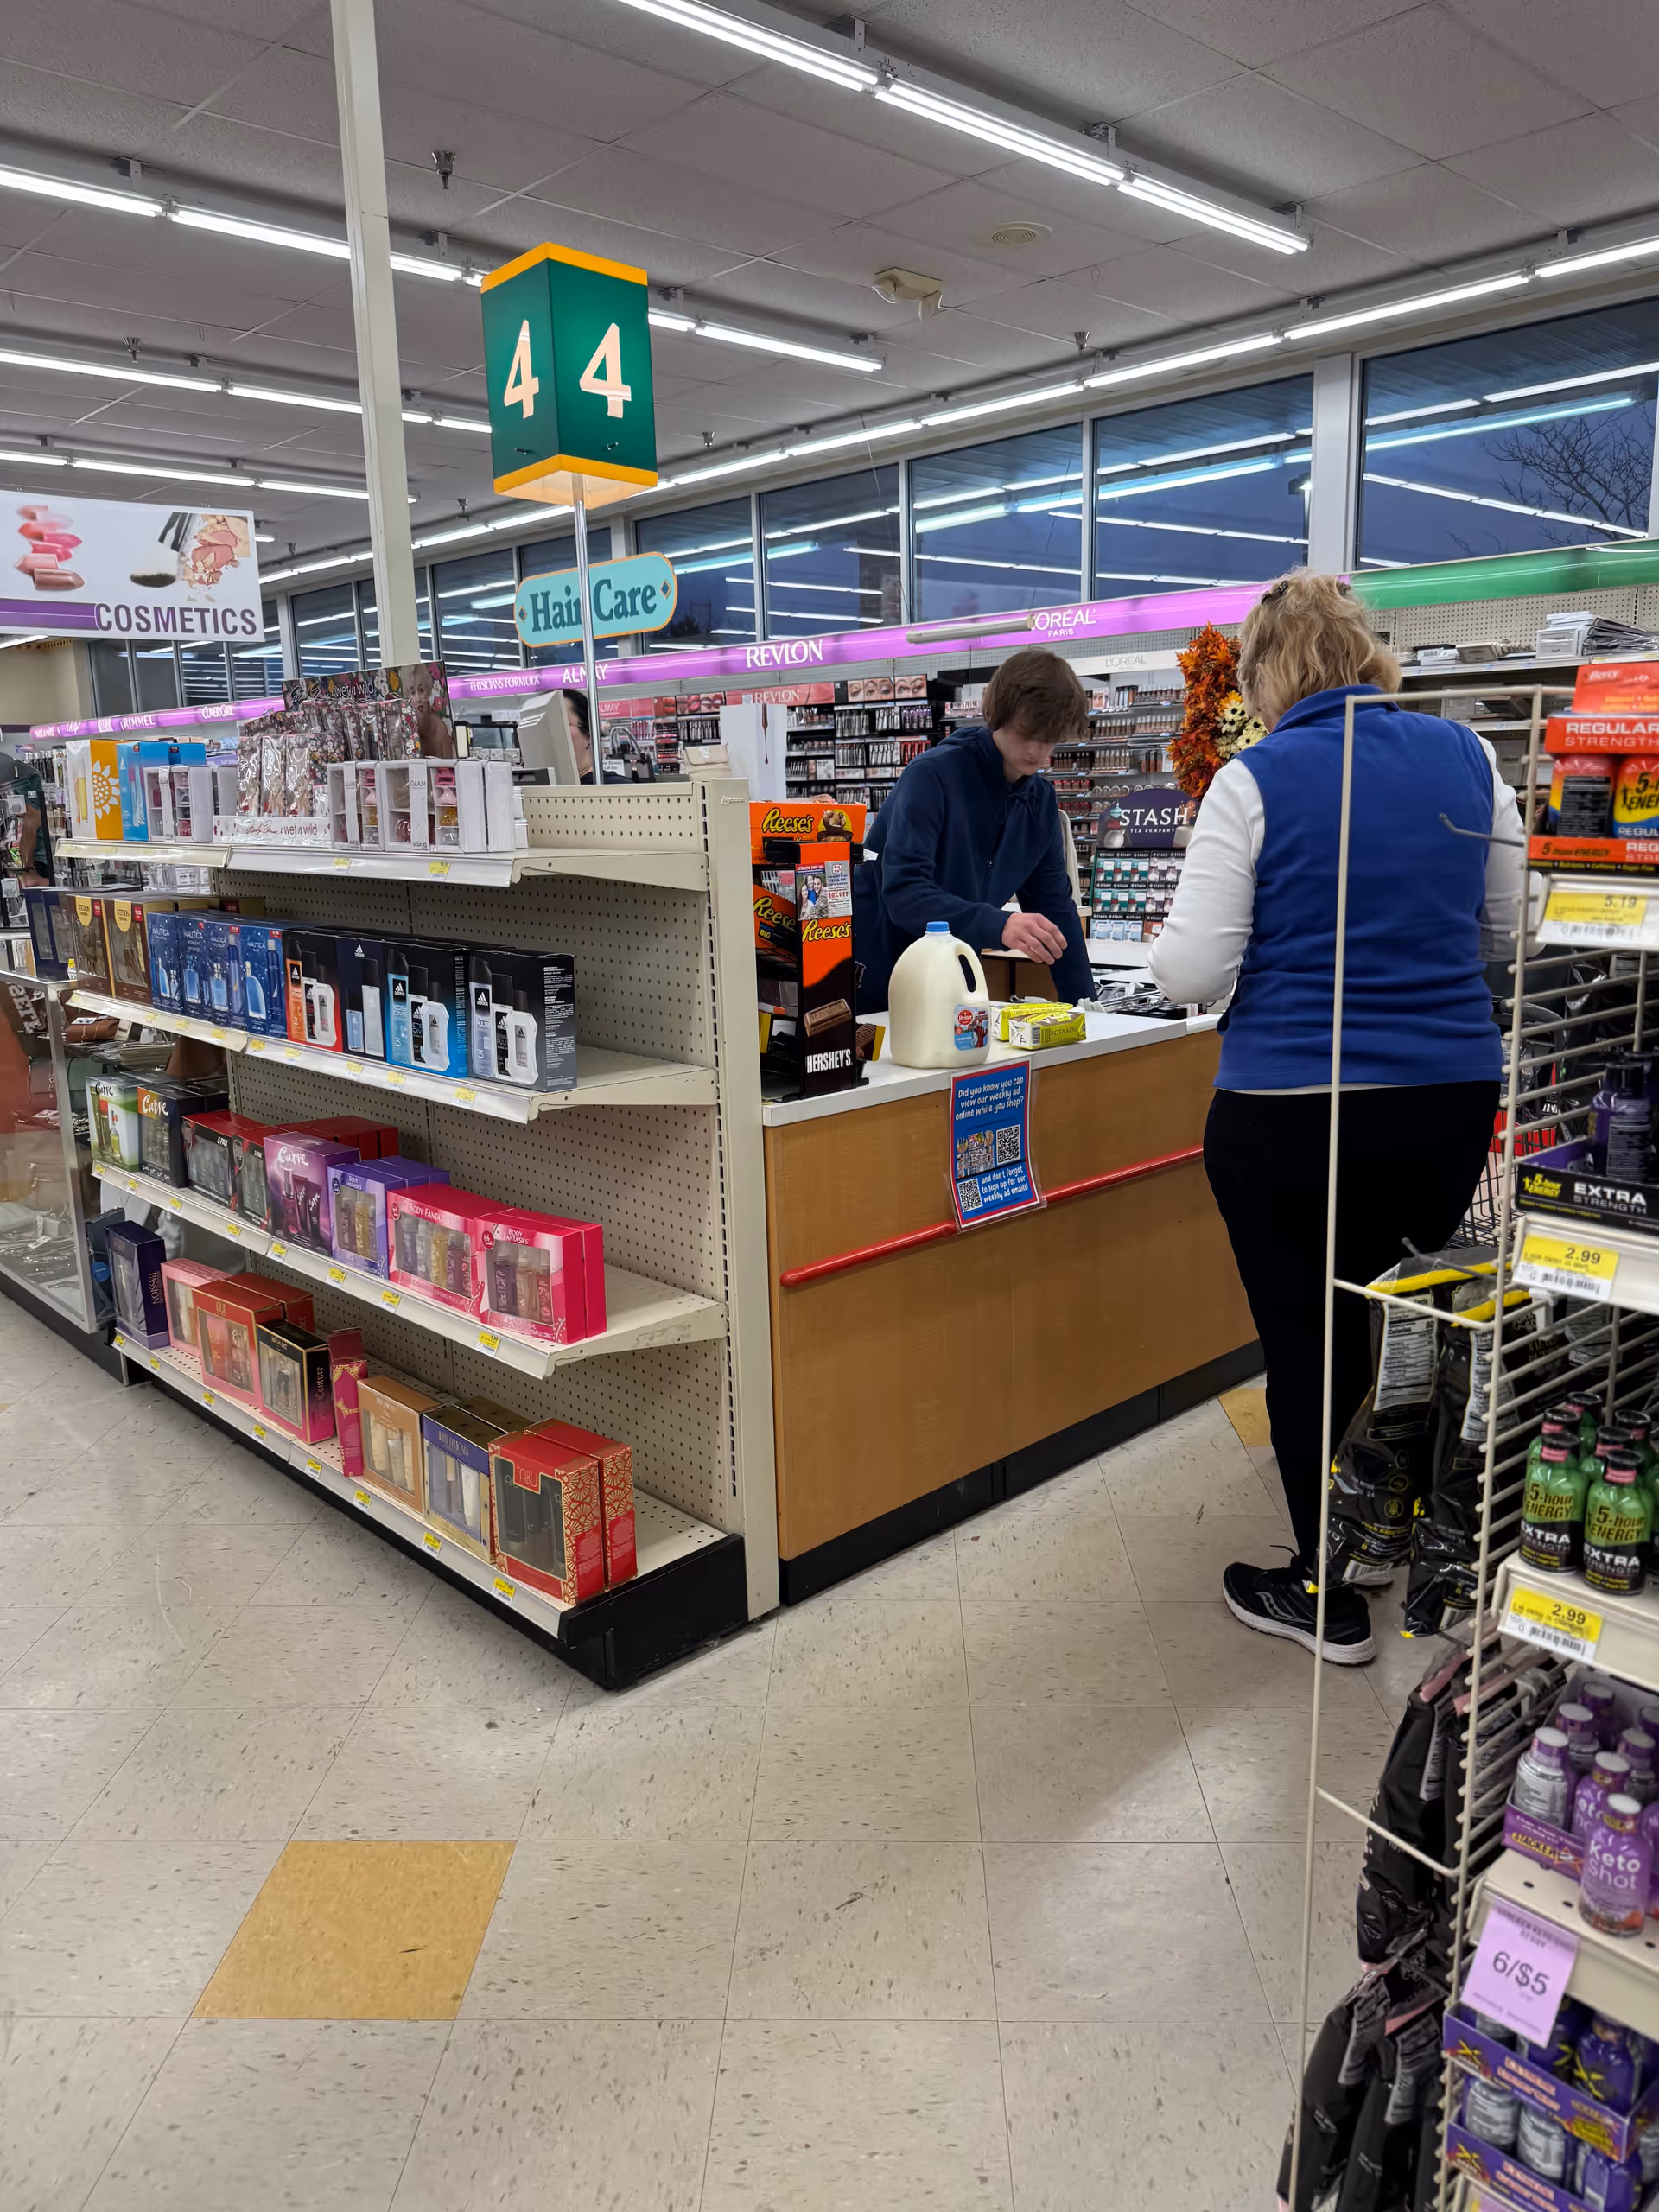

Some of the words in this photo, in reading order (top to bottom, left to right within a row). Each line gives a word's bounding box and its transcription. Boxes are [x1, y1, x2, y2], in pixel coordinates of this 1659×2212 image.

[503, 319, 539, 419] 4
[580, 322, 632, 419] 4
[530, 584, 582, 632] Hair
[594, 578, 657, 622] Care
[95, 603, 257, 636] COSMETICS
[1048, 628, 1074, 638] PARIS
[745, 639, 823, 668] REVLON
[754, 690, 800, 704] REVLON
[124, 715, 156, 728] RIMMEL
[1566, 722, 1659, 734] REGULAR
[762, 807, 814, 833] Reese's
[1120, 807, 1188, 826] STASH
[1618, 827, 1659, 836] REGUL
[753, 896, 797, 931] Reese
[184, 931, 204, 939] NAUTICA
[760, 929, 771, 939] BIG
[803, 919, 851, 943] Reese's
[806, 1048, 852, 1073] HERSHEY'S
[95, 1082, 114, 1096] Curve
[958, 1088, 969, 1098] Did
[969, 1085, 982, 1098] you
[983, 1080, 1001, 1092] know
[1001, 1079, 1013, 1090] you
[1013, 1076, 1024, 1085] can
[960, 1099, 976, 1109] view
[977, 1096, 988, 1106] our
[989, 1090, 1012, 1103] weekly
[1013, 1086, 1020, 1096] ad
[142, 1094, 169, 1116] Curve
[955, 1110, 975, 1122] online
[976, 1105, 994, 1116] while
[994, 1103, 1006, 1115] you
[1006, 1096, 1024, 1111] shop?
[278, 1146, 309, 1166] Curve
[981, 1185, 988, 1194] to
[988, 1183, 1000, 1195] sign
[1000, 1181, 1007, 1191] up
[1007, 1177, 1016, 1188] for
[1017, 1174, 1027, 1183] our
[992, 1170, 1006, 1181] don't
[1006, 1166, 1024, 1178] forget
[1534, 1173, 1562, 1190] 5-hour
[983, 1191, 1004, 1203] weekly
[1003, 1187, 1011, 1197] ad
[1529, 1185, 1561, 1198] ENERGY
[1574, 1182, 1647, 1205] EXTRA
[409, 1204, 423, 1215] BODY
[1573, 1195, 1647, 1215] STRENGTH
[503, 1234, 530, 1245] FANTASIES
[508, 1228, 523, 1237] BODY
[1565, 1246, 1601, 1265] 2.99
[149, 1272, 160, 1305] PASSION
[316, 1366, 325, 1398] Couture
[516, 1466, 537, 1488] TABU
[1529, 1483, 1574, 1505] 5-hour
[1525, 1501, 1573, 1519] ENERGY
[1597, 1505, 1646, 1529] 5-hour
[1521, 1519, 1571, 1544] EXTRA
[1591, 1524, 1644, 1541] ENERGY
[1583, 1542, 1641, 1567] EXTRA
[1551, 1604, 1586, 1625] 2.99
[1589, 1840, 1641, 1872] Keto
[1589, 1857, 1637, 1889] Shot
[1492, 1950, 1550, 1996] 6/$5
